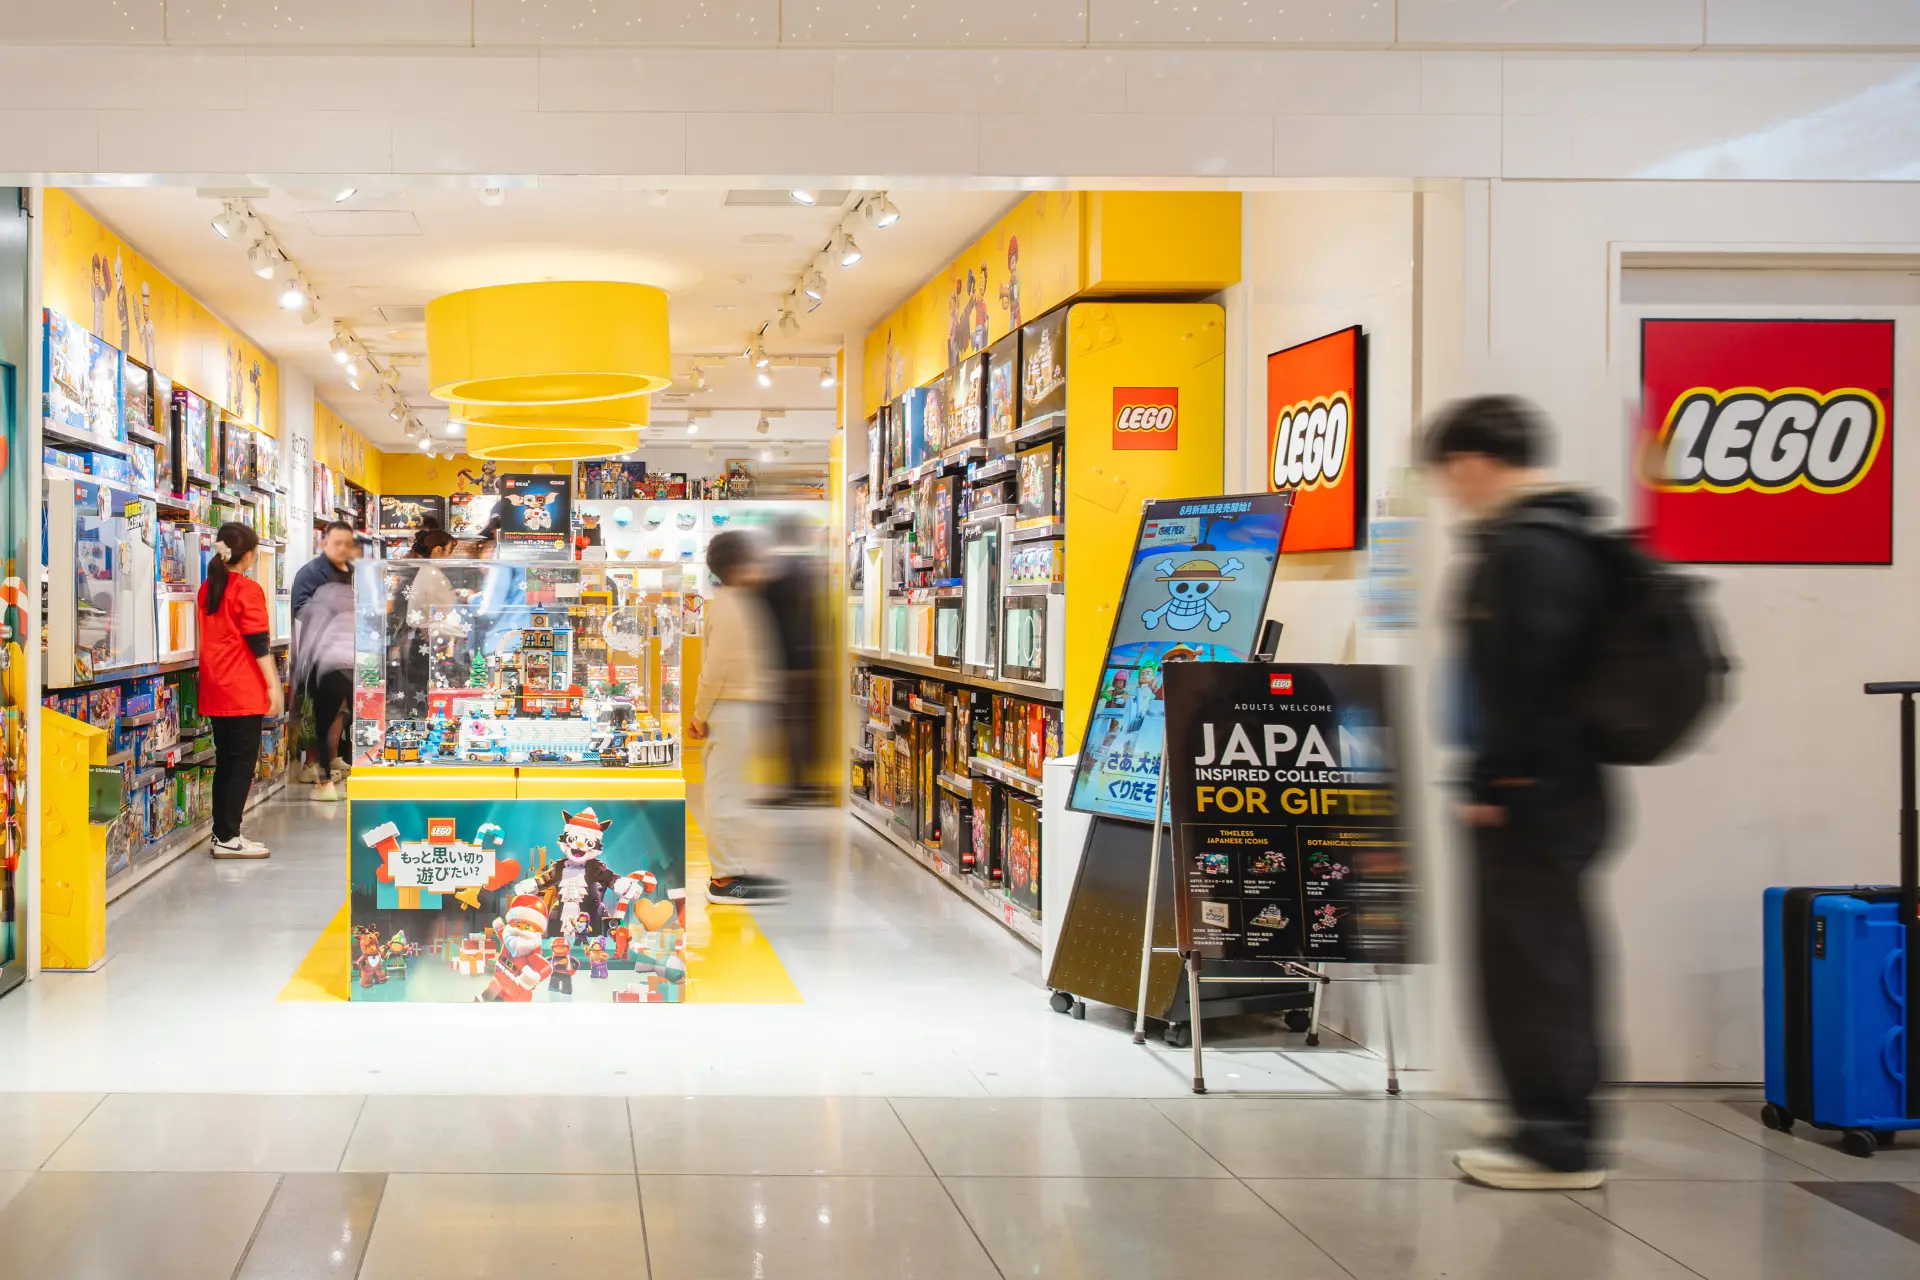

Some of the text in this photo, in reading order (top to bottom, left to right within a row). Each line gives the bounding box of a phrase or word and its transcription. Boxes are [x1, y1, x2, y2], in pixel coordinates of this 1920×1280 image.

[1118, 406, 1174, 431] LEGO
[1273, 399, 1348, 487] LEGO
[1661, 396, 1876, 486] LEGO
[1271, 679, 1292, 688] LEGO
[1234, 703, 1333, 712] ADULTS WELCOME
[1195, 768, 1270, 782] INSPIRED
[1196, 786, 1270, 814] FOR
[431, 826, 452, 836] LEGO
[1220, 829, 1255, 837] TIMELESS
[1206, 837, 1244, 845] JAPANESE
[401, 847, 484, 865] もっと思い切り
[416, 866, 480, 884] 遊びたい?
